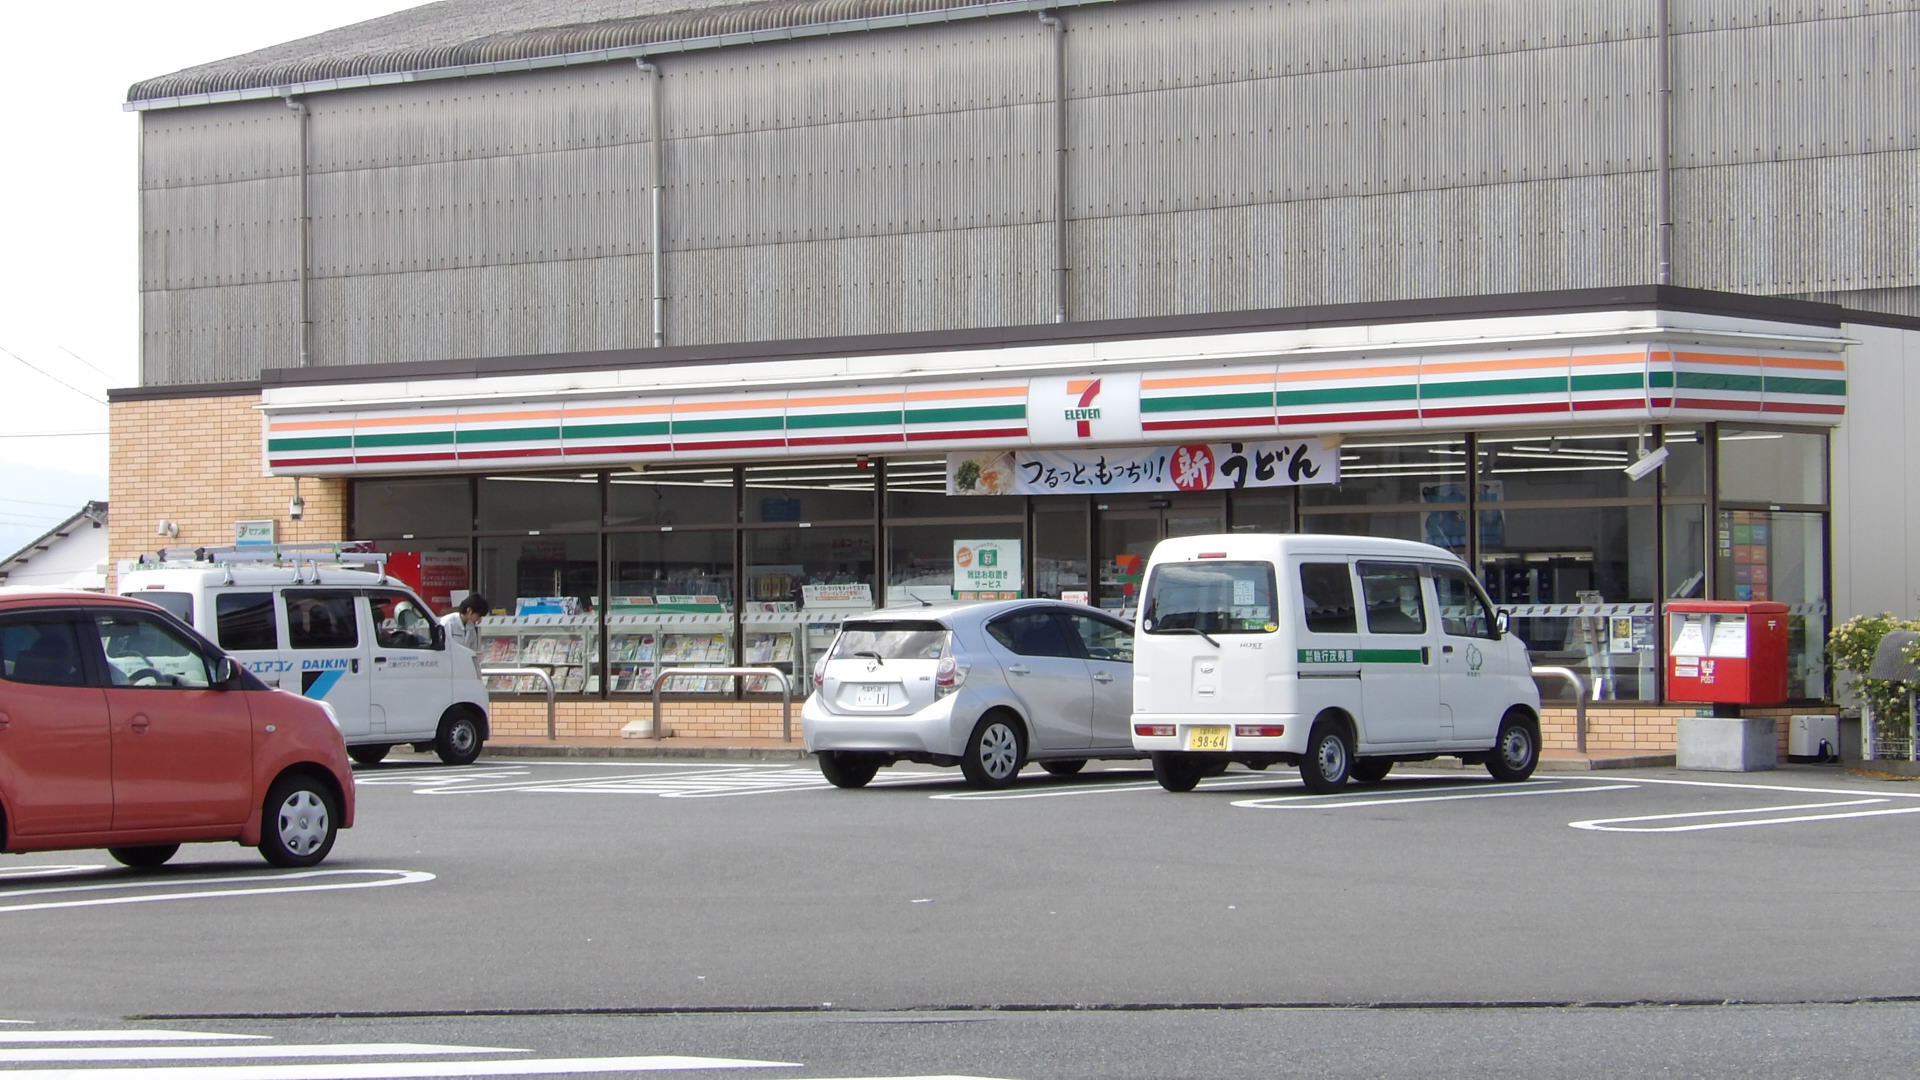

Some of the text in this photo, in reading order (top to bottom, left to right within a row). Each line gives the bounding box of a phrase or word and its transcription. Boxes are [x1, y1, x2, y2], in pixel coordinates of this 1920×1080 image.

[1175, 447, 1210, 488] 新
[1220, 442, 1321, 488] うどん
[302, 658, 348, 670] DAIKIN
[1701, 676, 1715, 684] POST
